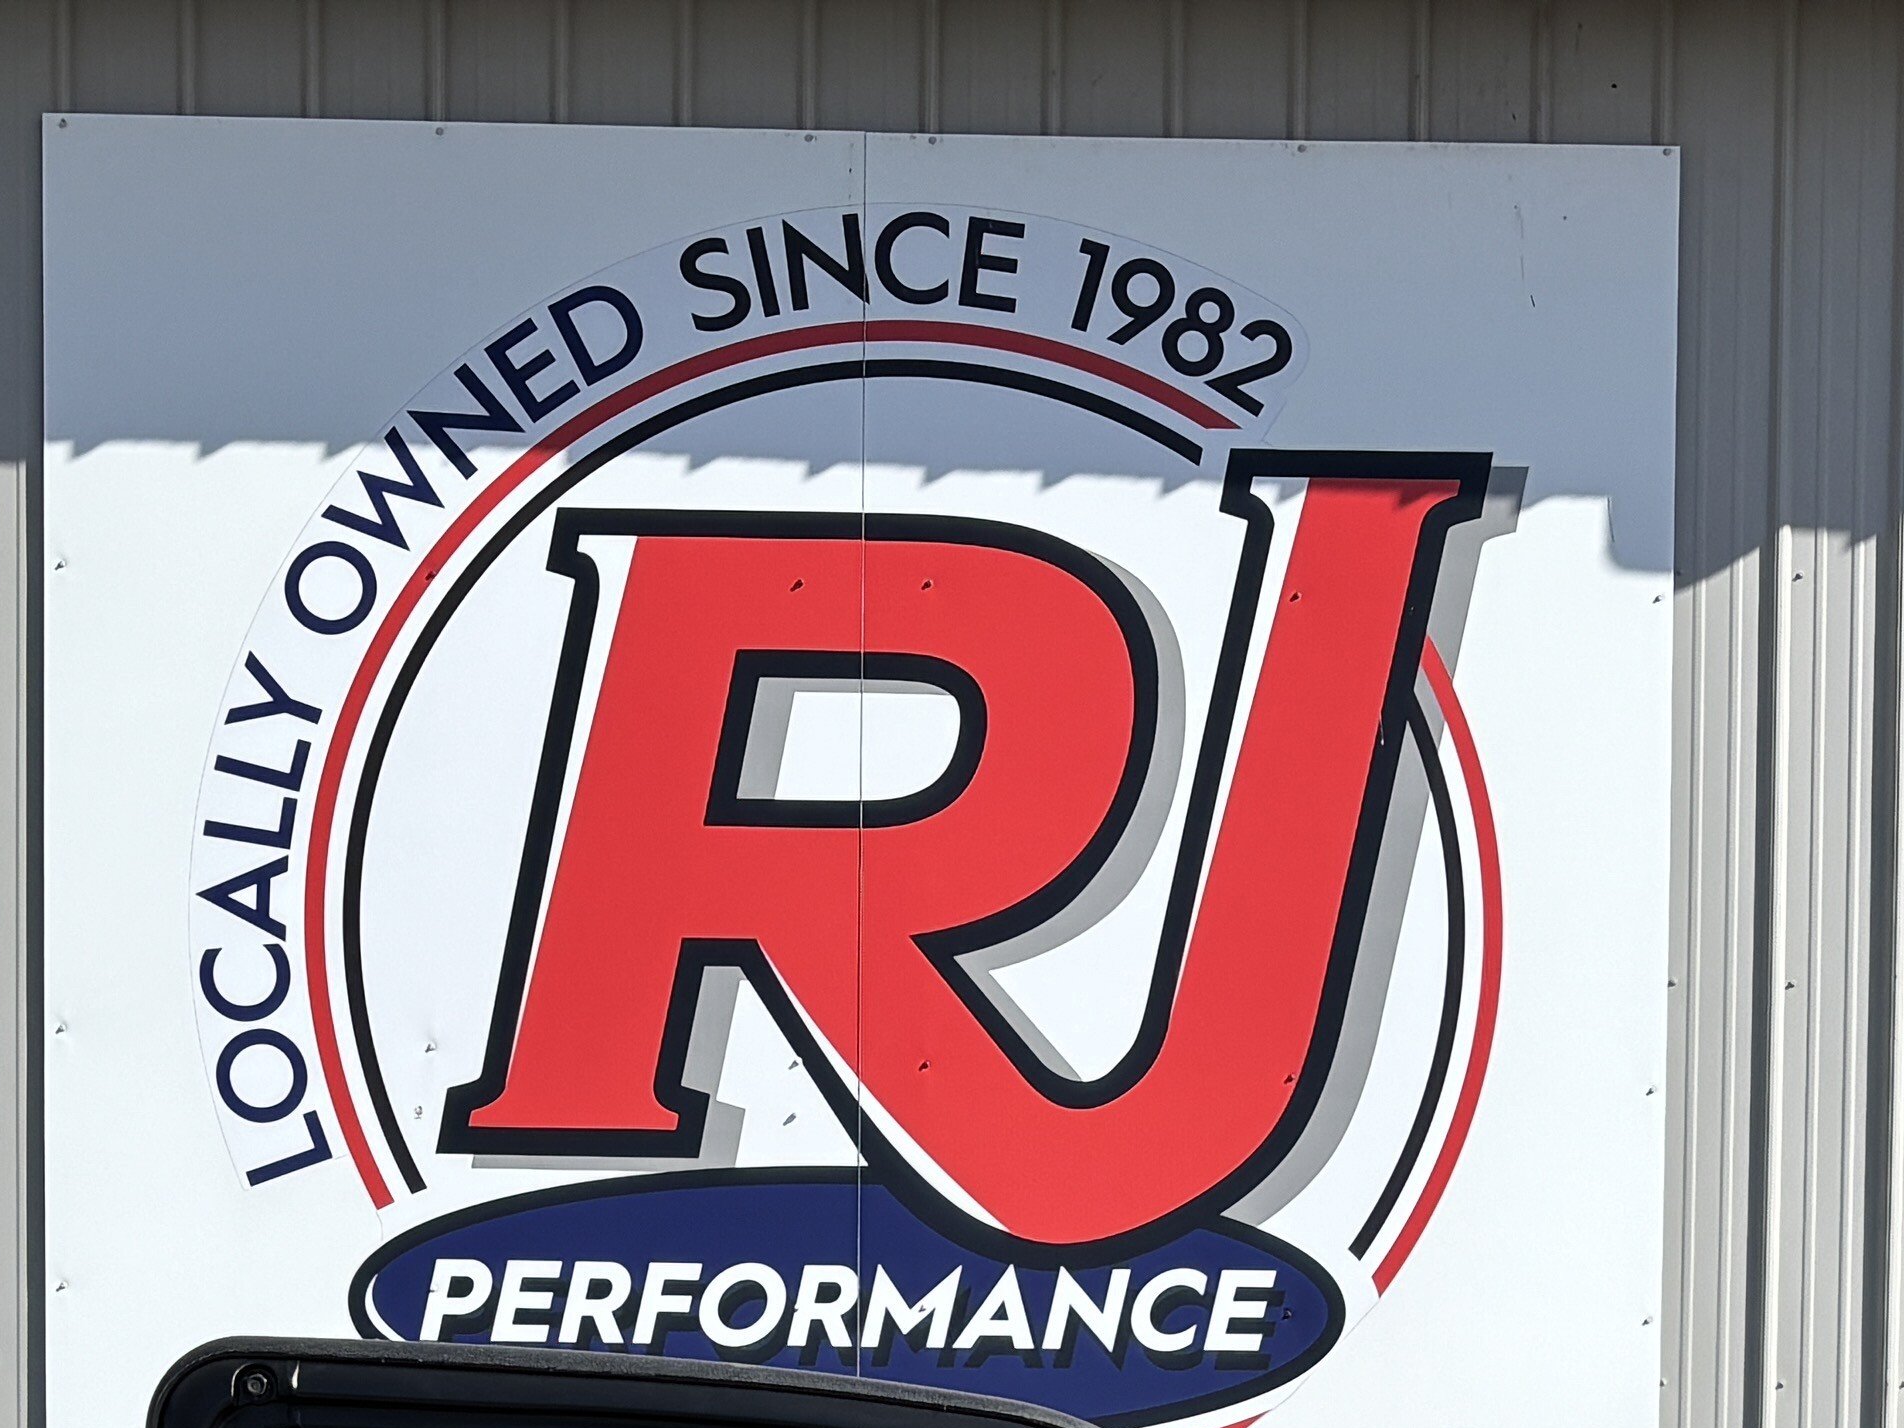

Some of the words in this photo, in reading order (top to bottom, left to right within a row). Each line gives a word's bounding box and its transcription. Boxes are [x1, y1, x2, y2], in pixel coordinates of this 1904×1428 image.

[195, 651, 333, 1186] LOCALLY
[283, 284, 645, 635] OWNED
[679, 211, 1026, 332] SINCE
[1070, 237, 1294, 417] 1982
[439, 449, 1495, 1264] RJ
[418, 1257, 1277, 1353] PERFORMANCE
